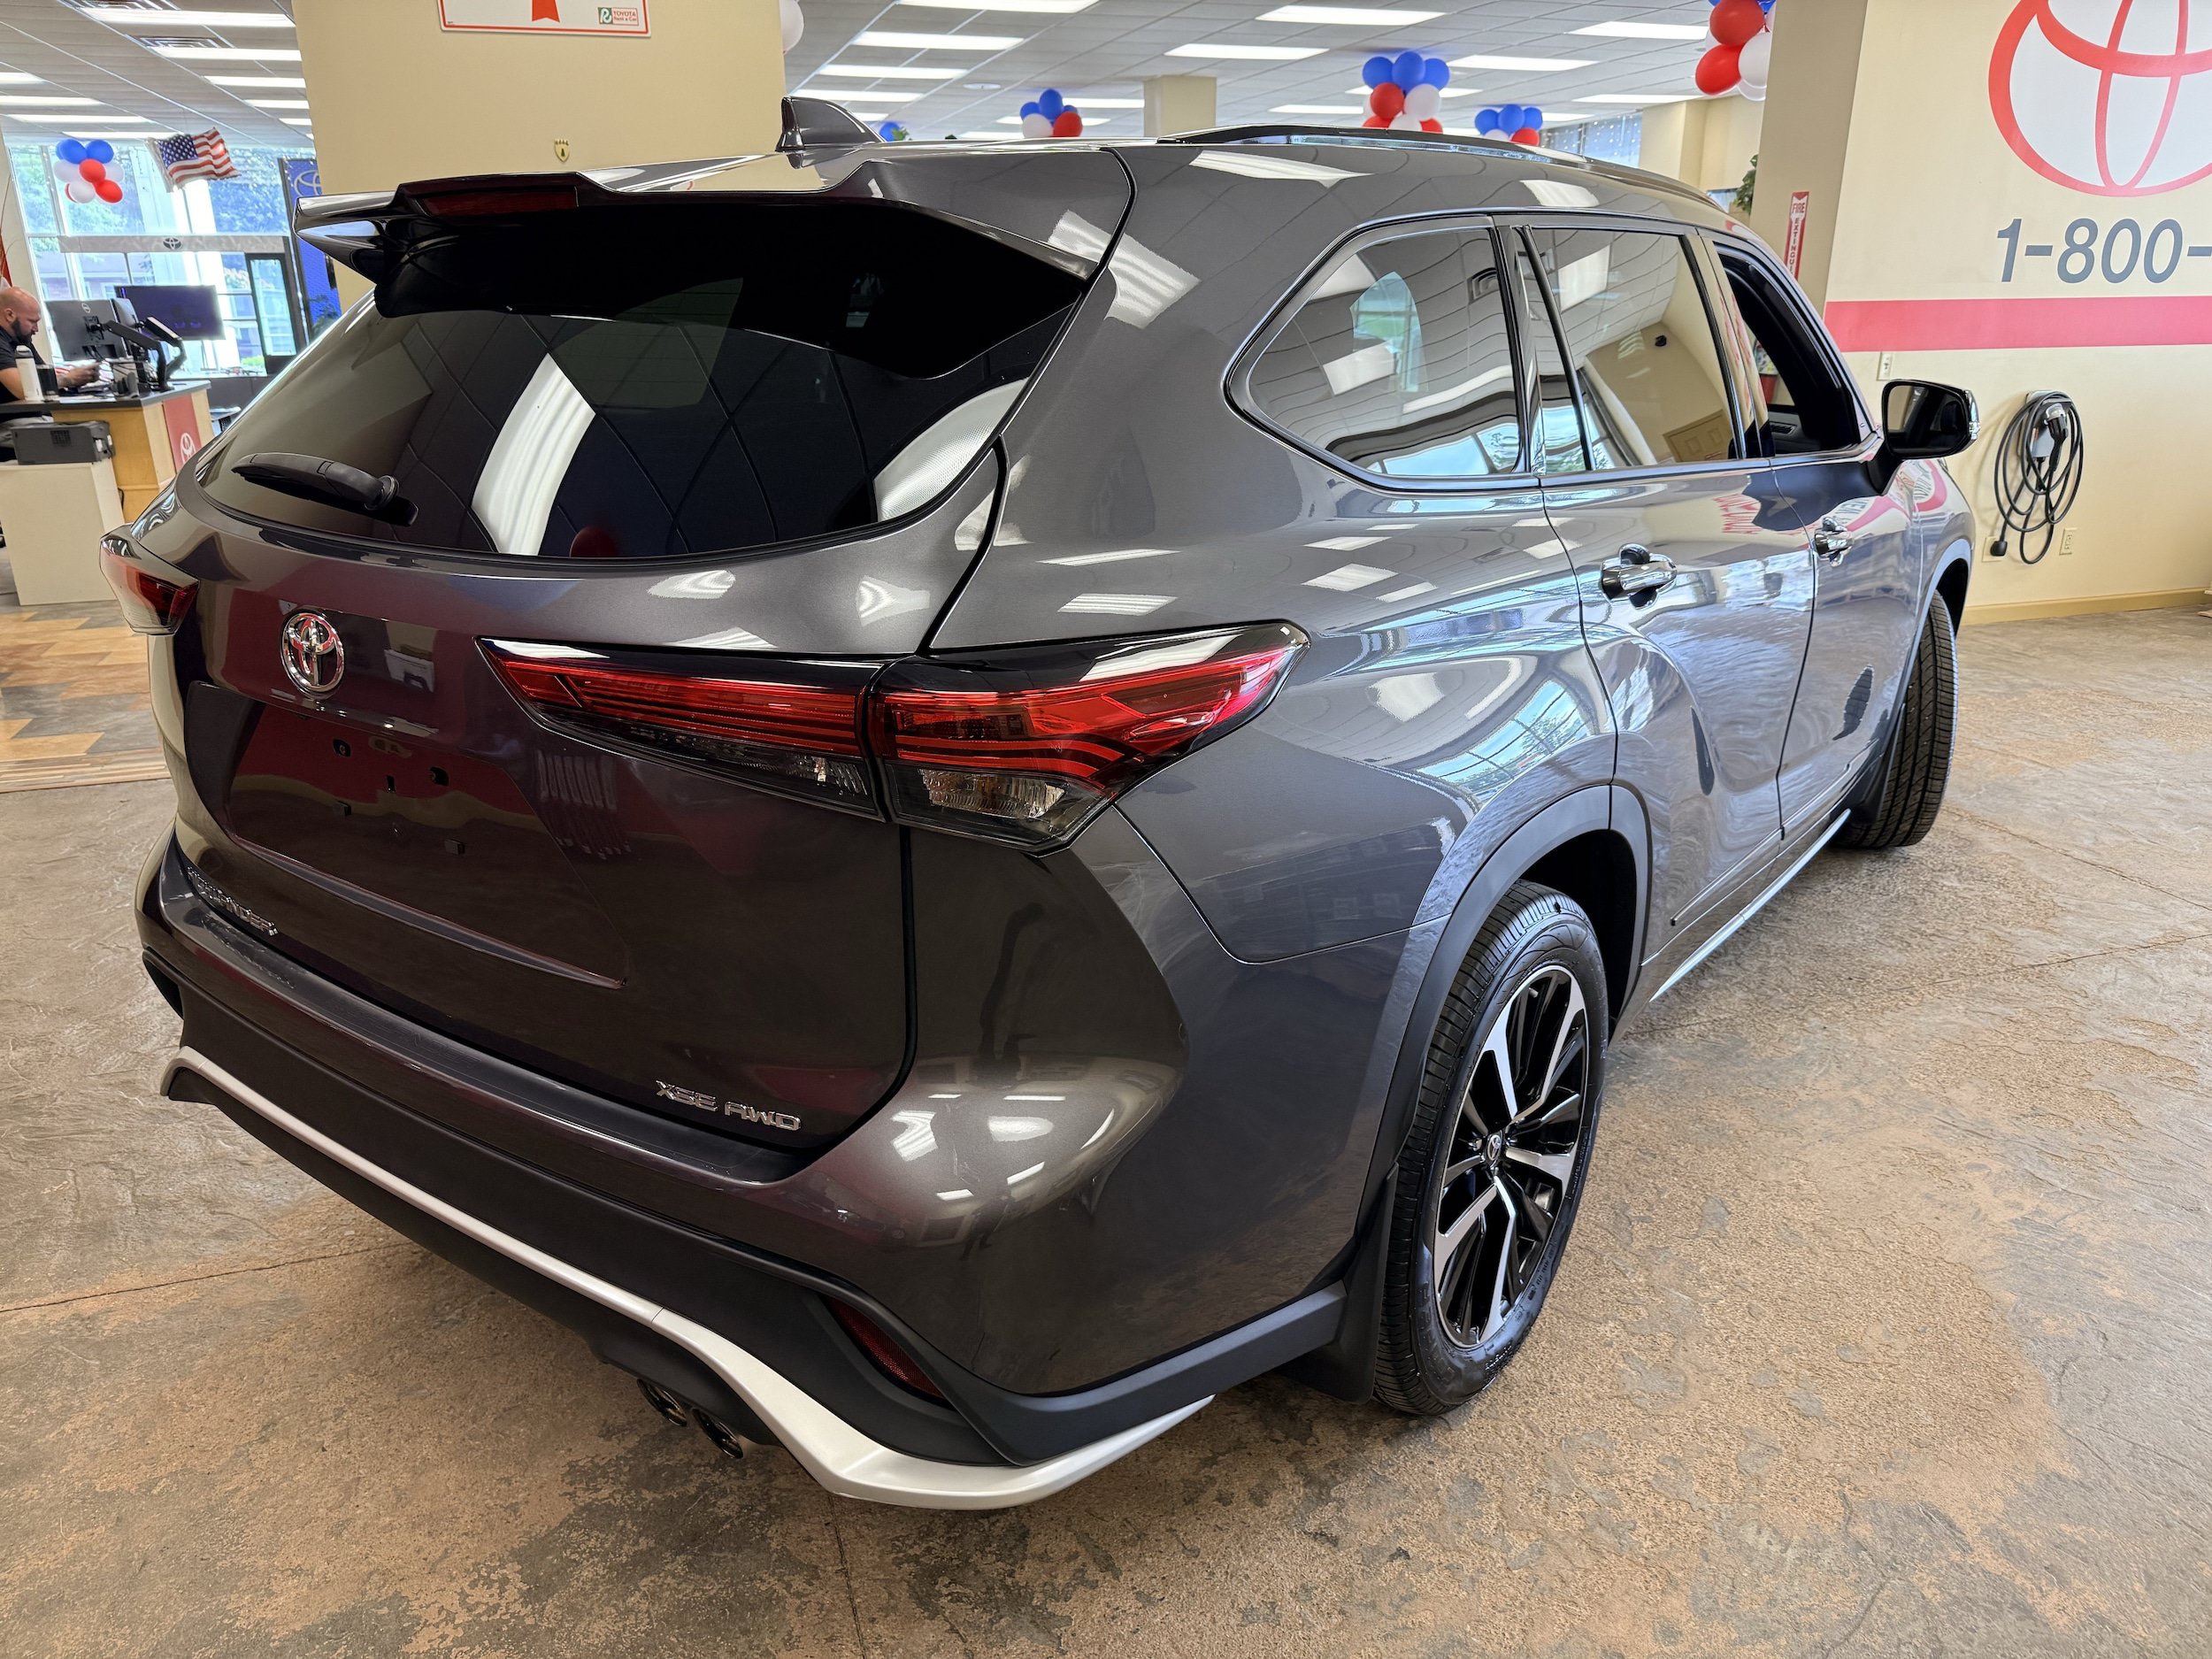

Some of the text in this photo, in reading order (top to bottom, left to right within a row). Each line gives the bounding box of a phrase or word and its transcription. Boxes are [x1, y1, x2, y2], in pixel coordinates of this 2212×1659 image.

[1791, 203, 1806, 213] FIRE
[1788, 217, 1800, 275] EXTINGUI
[1996, 218, 2212, 284] 1-800-
[656, 1079, 802, 1132] XSE AWD
